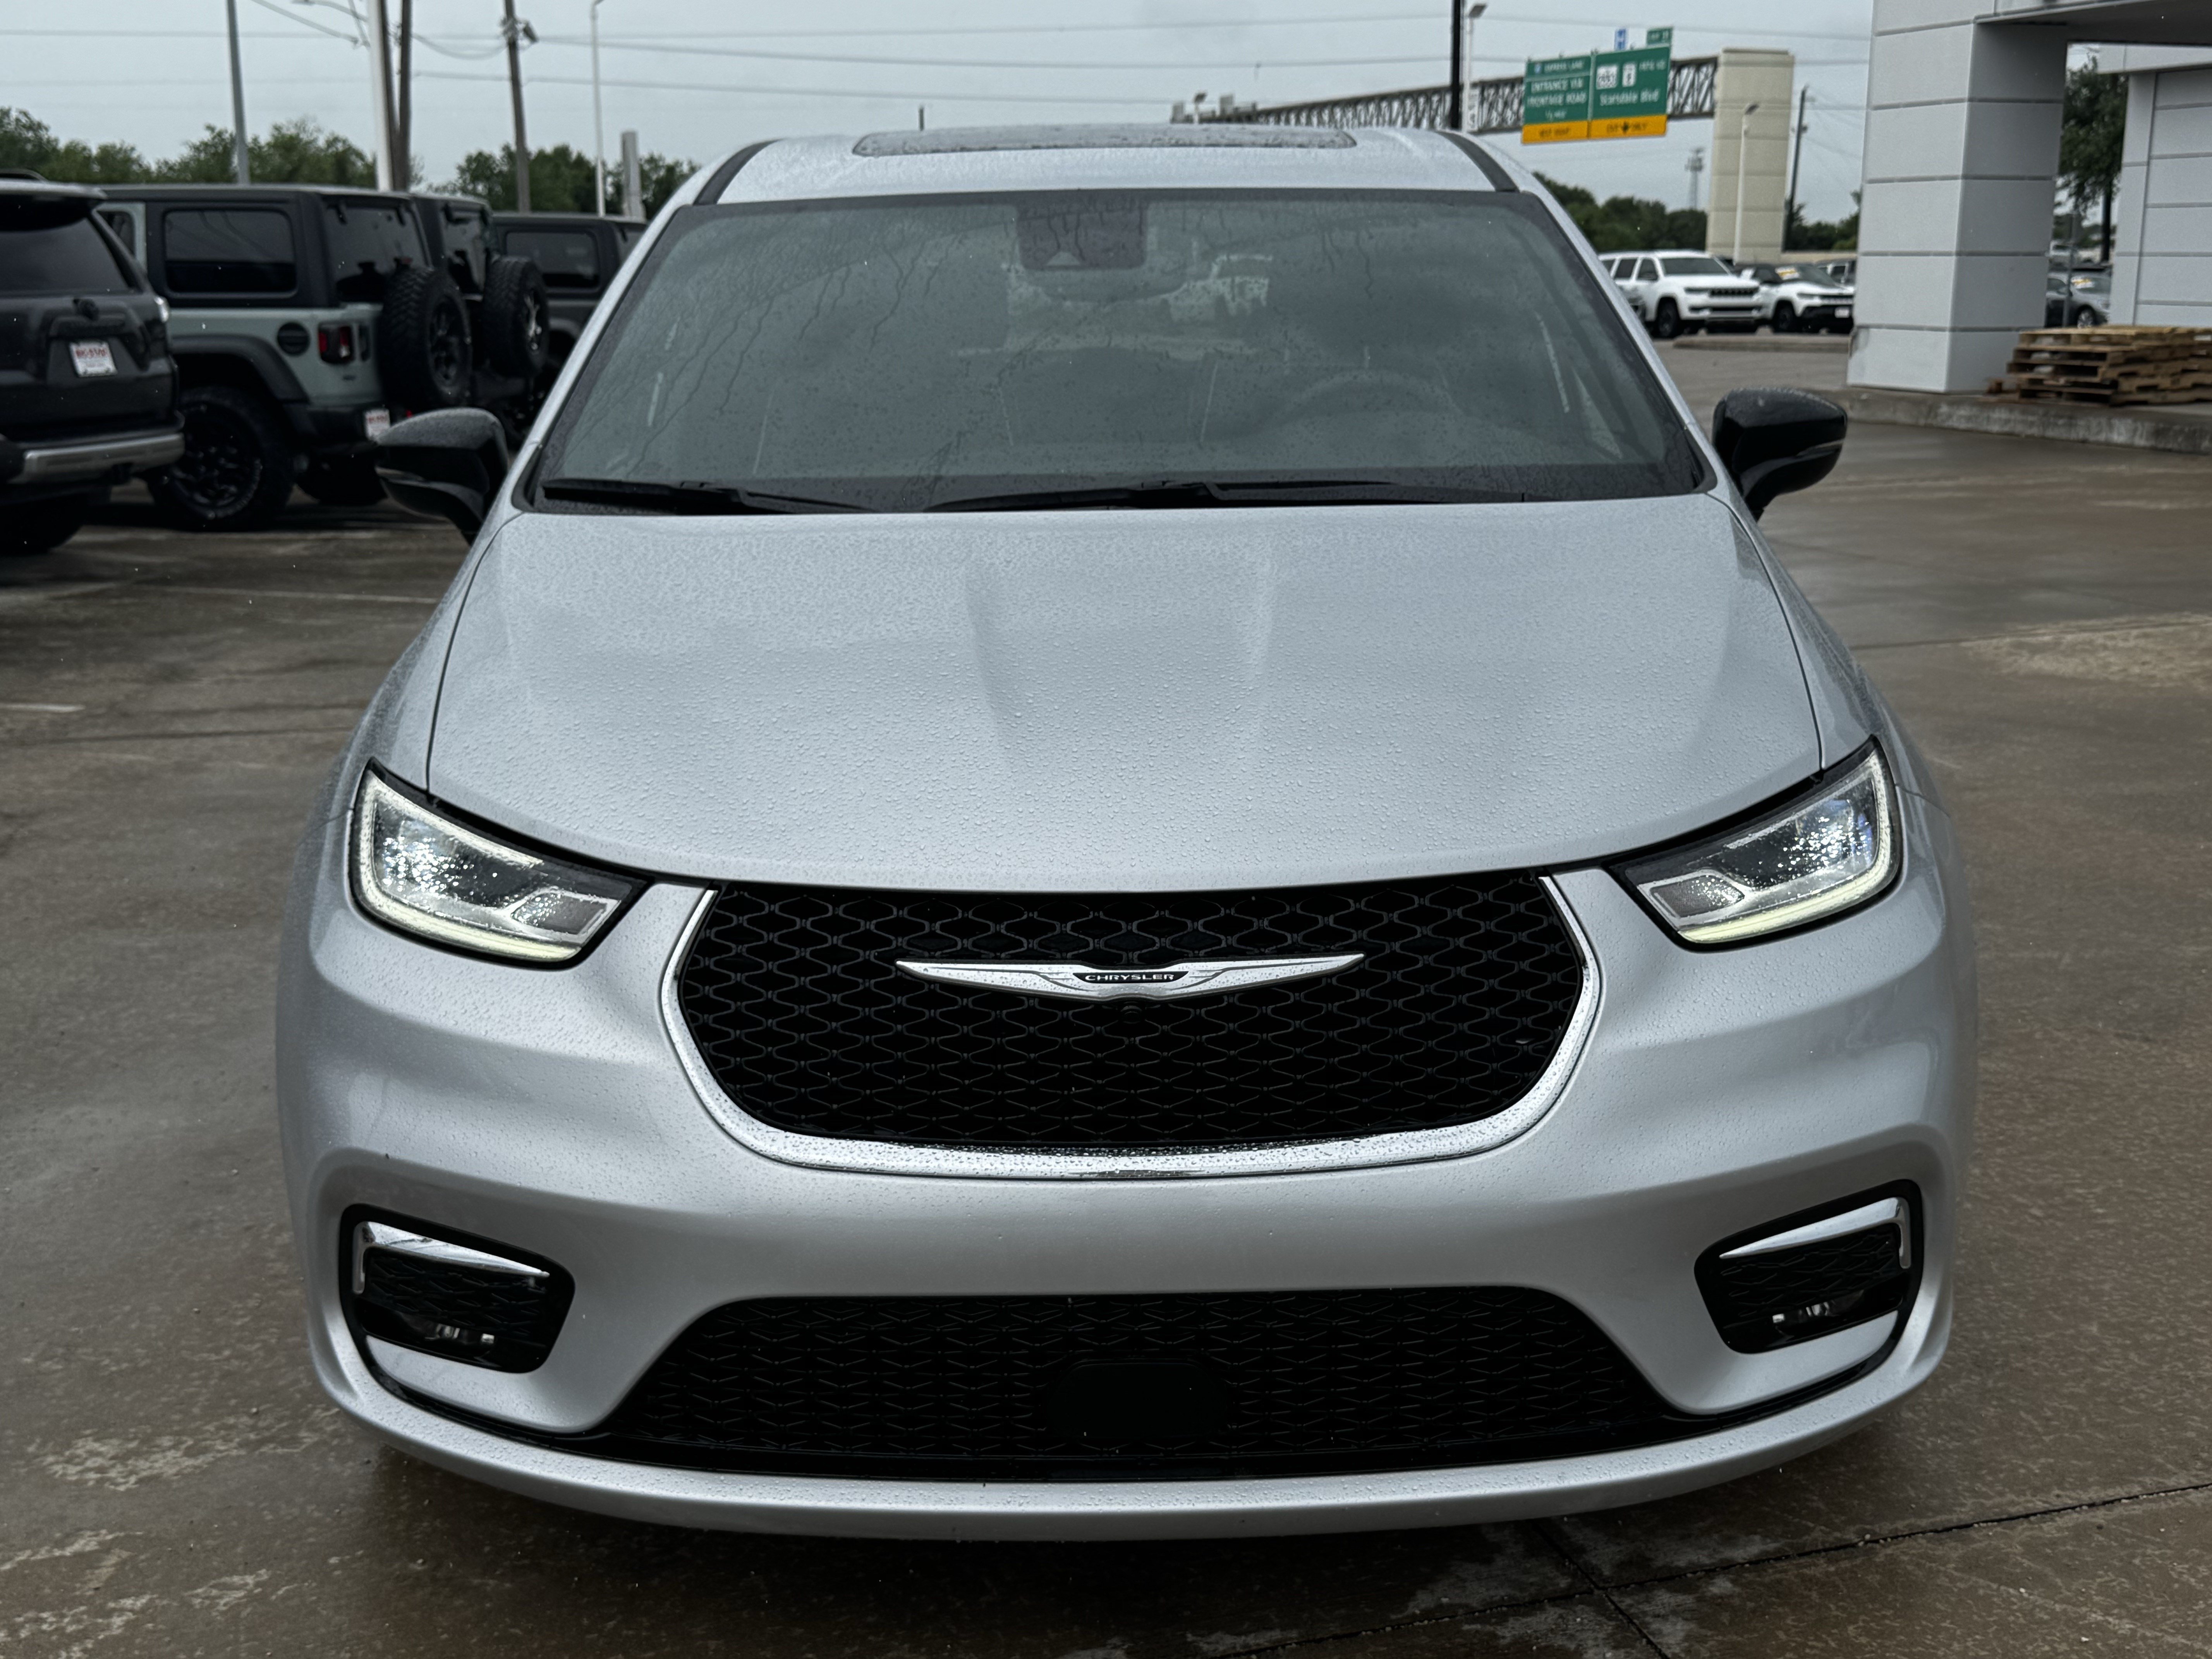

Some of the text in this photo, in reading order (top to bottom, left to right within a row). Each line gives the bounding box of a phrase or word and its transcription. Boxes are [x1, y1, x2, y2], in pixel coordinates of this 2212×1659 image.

[1531, 79, 1568, 93] ENTRANCE
[1566, 91, 1586, 104] ROAD
[1640, 89, 1660, 103] Blvd
